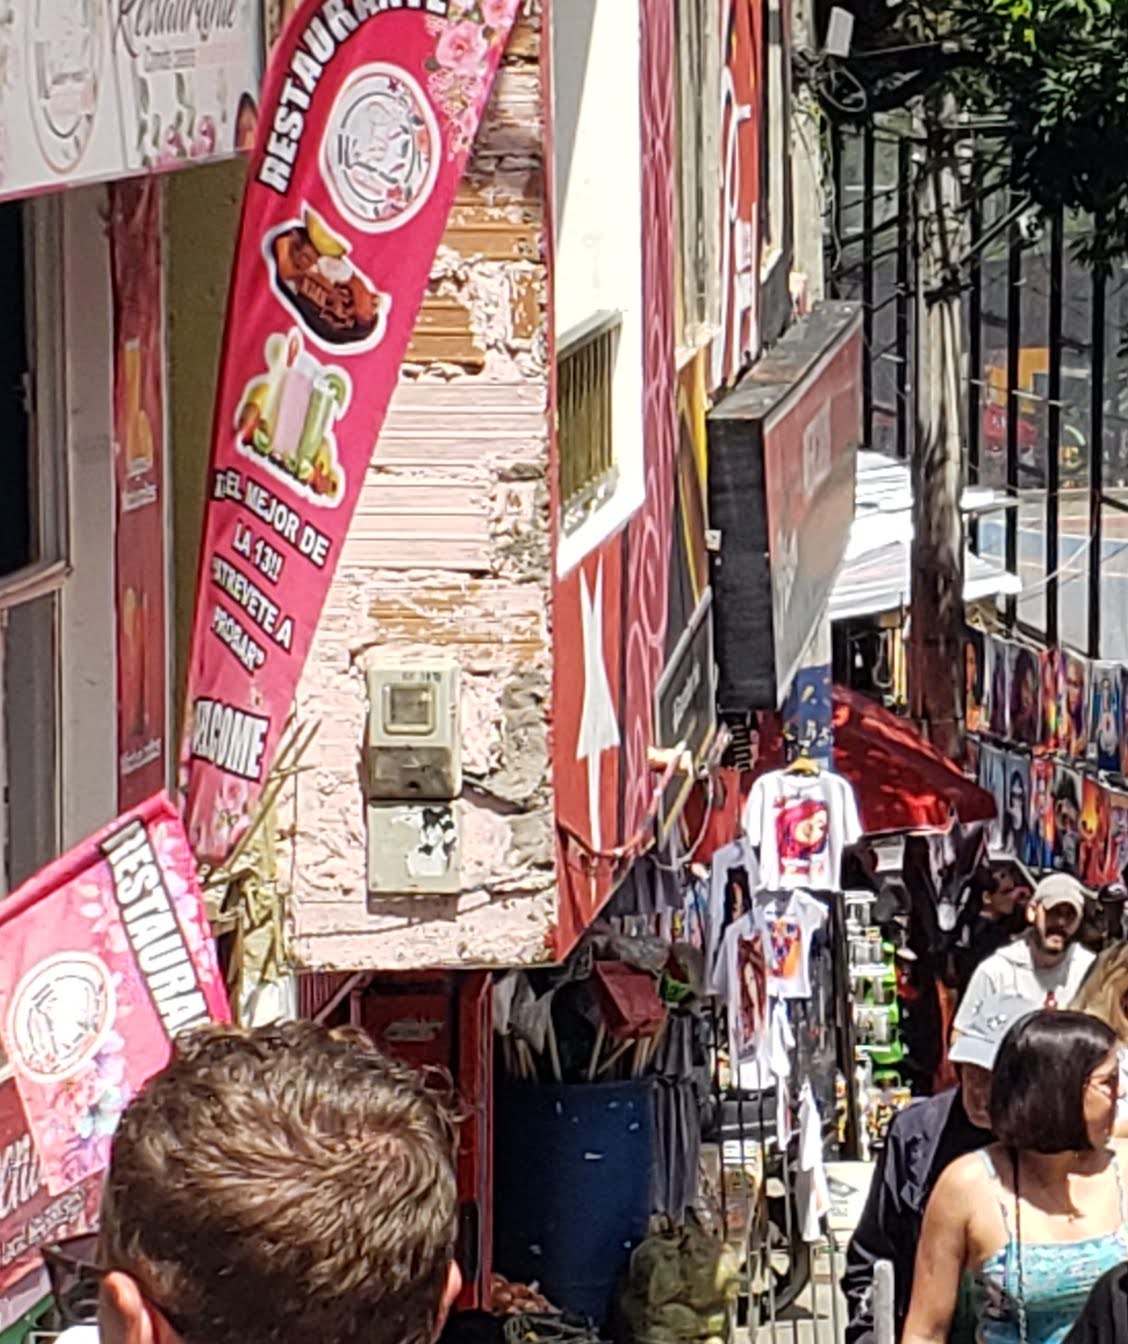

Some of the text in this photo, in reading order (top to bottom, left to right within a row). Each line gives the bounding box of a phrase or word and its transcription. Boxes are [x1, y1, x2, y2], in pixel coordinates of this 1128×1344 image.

[232, 523, 253, 558] LA
[246, 479, 299, 542] MEJOR
[300, 528, 329, 567] DE
[275, 618, 293, 650] A
